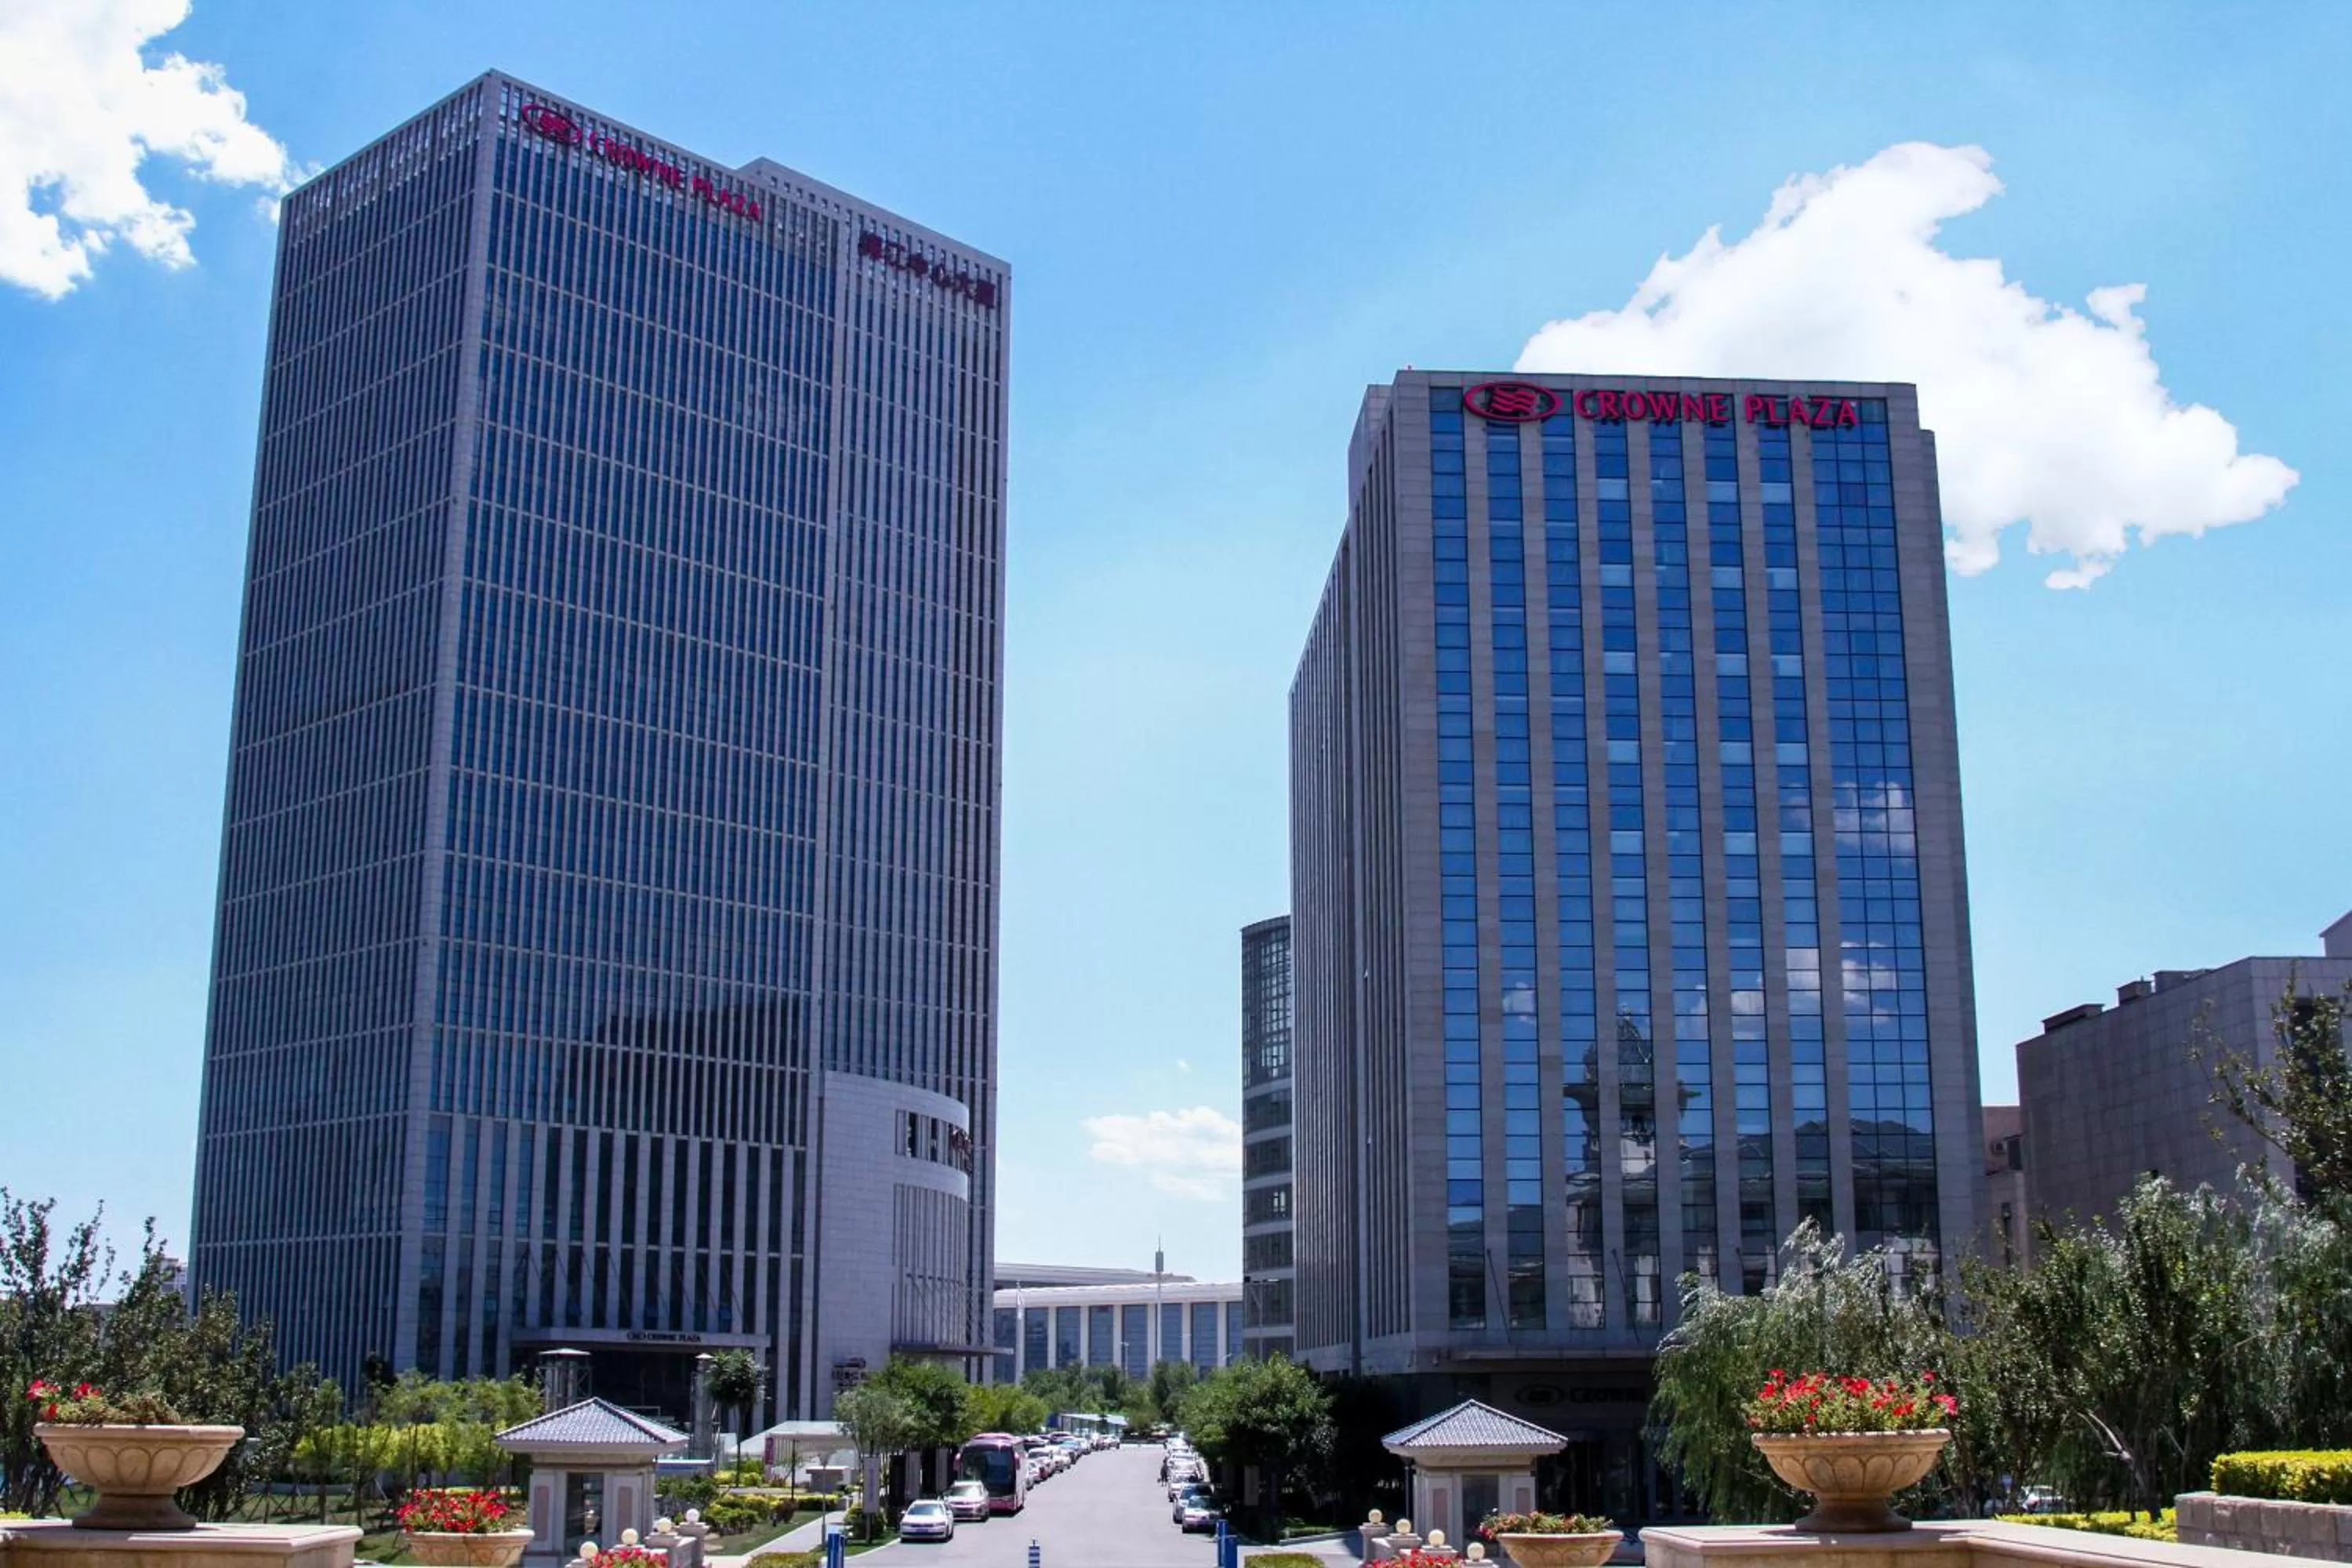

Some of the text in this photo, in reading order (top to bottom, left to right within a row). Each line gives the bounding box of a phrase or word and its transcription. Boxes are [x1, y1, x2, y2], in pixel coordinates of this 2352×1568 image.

[590, 130, 760, 221] CROWNE PLAZA
[1574, 390, 1857, 425] CROWNE PLAZA
